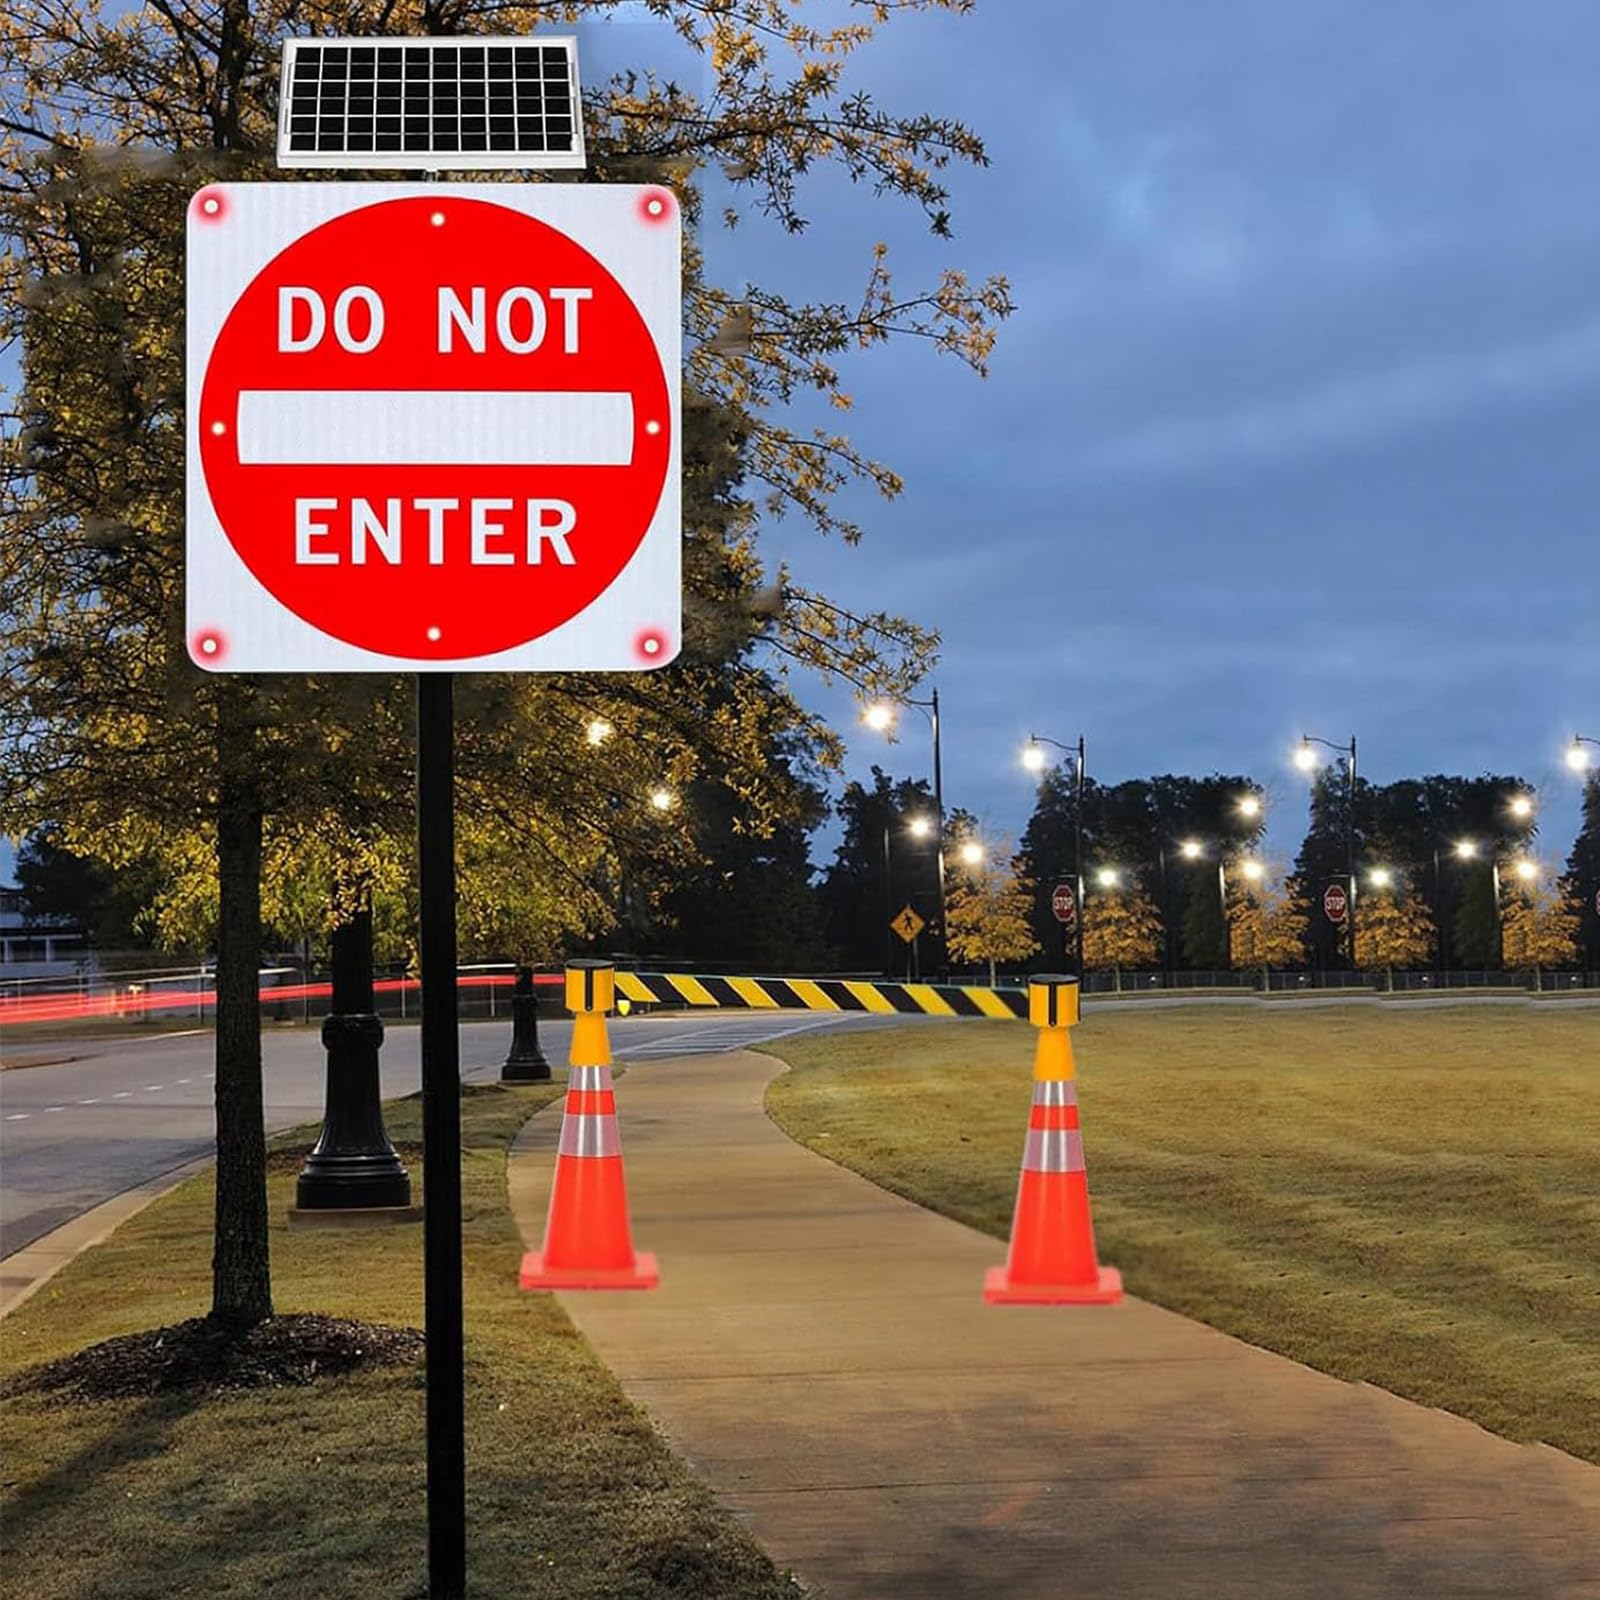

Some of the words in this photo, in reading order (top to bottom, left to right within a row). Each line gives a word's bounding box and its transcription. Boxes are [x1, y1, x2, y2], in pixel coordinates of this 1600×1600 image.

[278, 285, 385, 355] DO
[437, 286, 593, 355] NOT
[294, 497, 577, 566] ENTER
[1054, 896, 1073, 910] STOP
[1326, 896, 1345, 910] STOP
